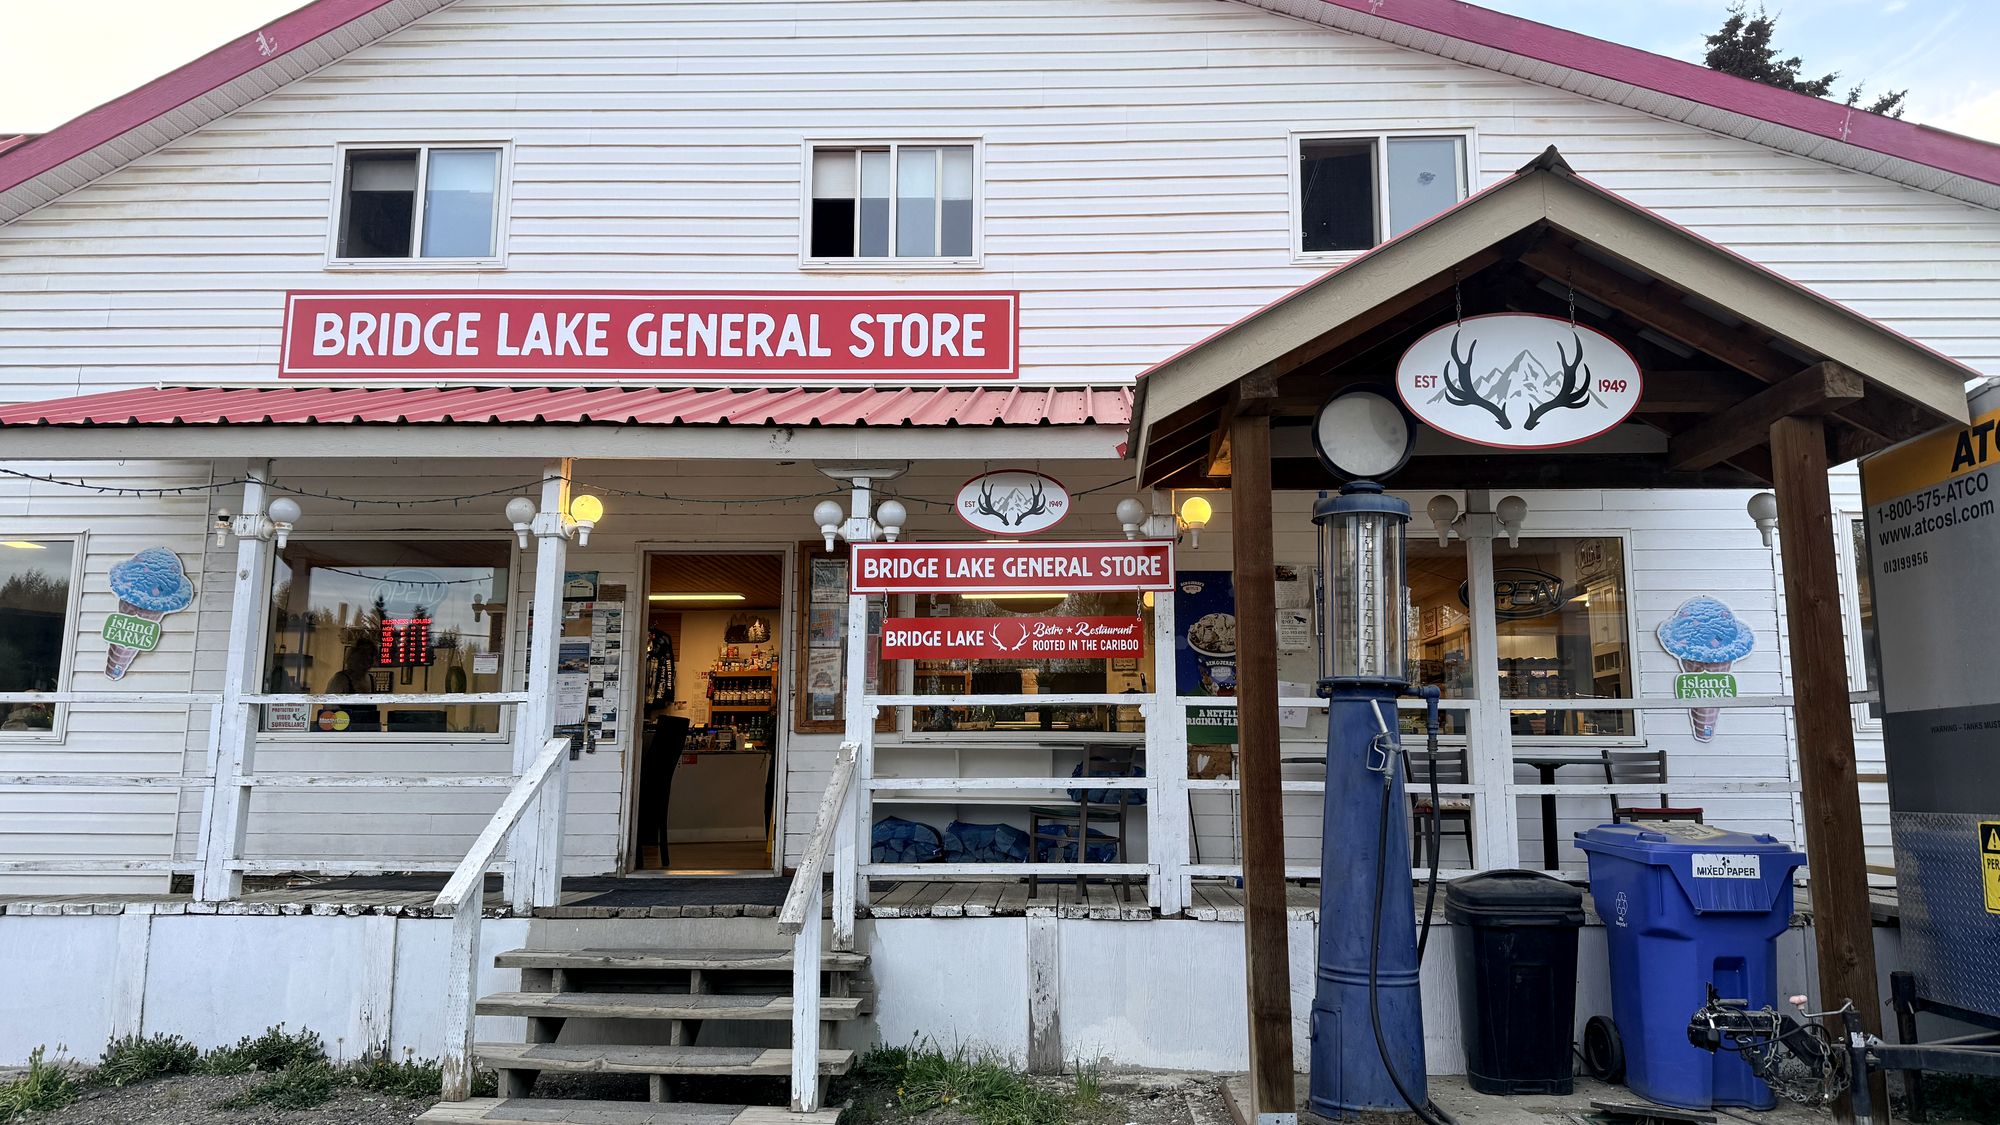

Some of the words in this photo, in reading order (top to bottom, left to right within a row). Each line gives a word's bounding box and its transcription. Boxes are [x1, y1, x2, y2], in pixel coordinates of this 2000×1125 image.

[313, 312, 481, 356] BRIDGE
[497, 312, 611, 356] LAKE
[626, 312, 832, 357] GENERAL
[848, 312, 986, 358] STORE
[1414, 375, 1438, 388] EST
[1598, 379, 1628, 392] 1949
[1951, 418, 2000, 473] AT
[964, 500, 976, 508] EST
[1049, 500, 1063, 508] 1949
[1877, 472, 1989, 525] 1-800-575-ATCO
[1879, 499, 1995, 546] www.atcosl.com
[864, 558, 939, 579] BRIDGE
[946, 557, 995, 578] LAKE
[1002, 556, 1093, 578] GENERAL
[1100, 555, 1162, 577] STORE
[1493, 579, 1563, 605] PEN
[111, 616, 155, 635] island
[1033, 622, 1064, 637] Bistro
[1075, 621, 1138, 637] Restaurant
[105, 626, 153, 648] FARMS
[885, 630, 942, 647] BRIDGE
[947, 630, 985, 646] LAKE
[1033, 640, 1065, 651] ROOTED
[1068, 639, 1078, 651] IN
[1081, 639, 1098, 651] THE
[1100, 639, 1139, 651] CARIBOO
[1682, 675, 1730, 689] island
[1680, 688, 1734, 699] FARMS
[1199, 709, 1206, 718] A
[1697, 866, 1725, 876] MIXED
[1727, 867, 1756, 877] PAPER
